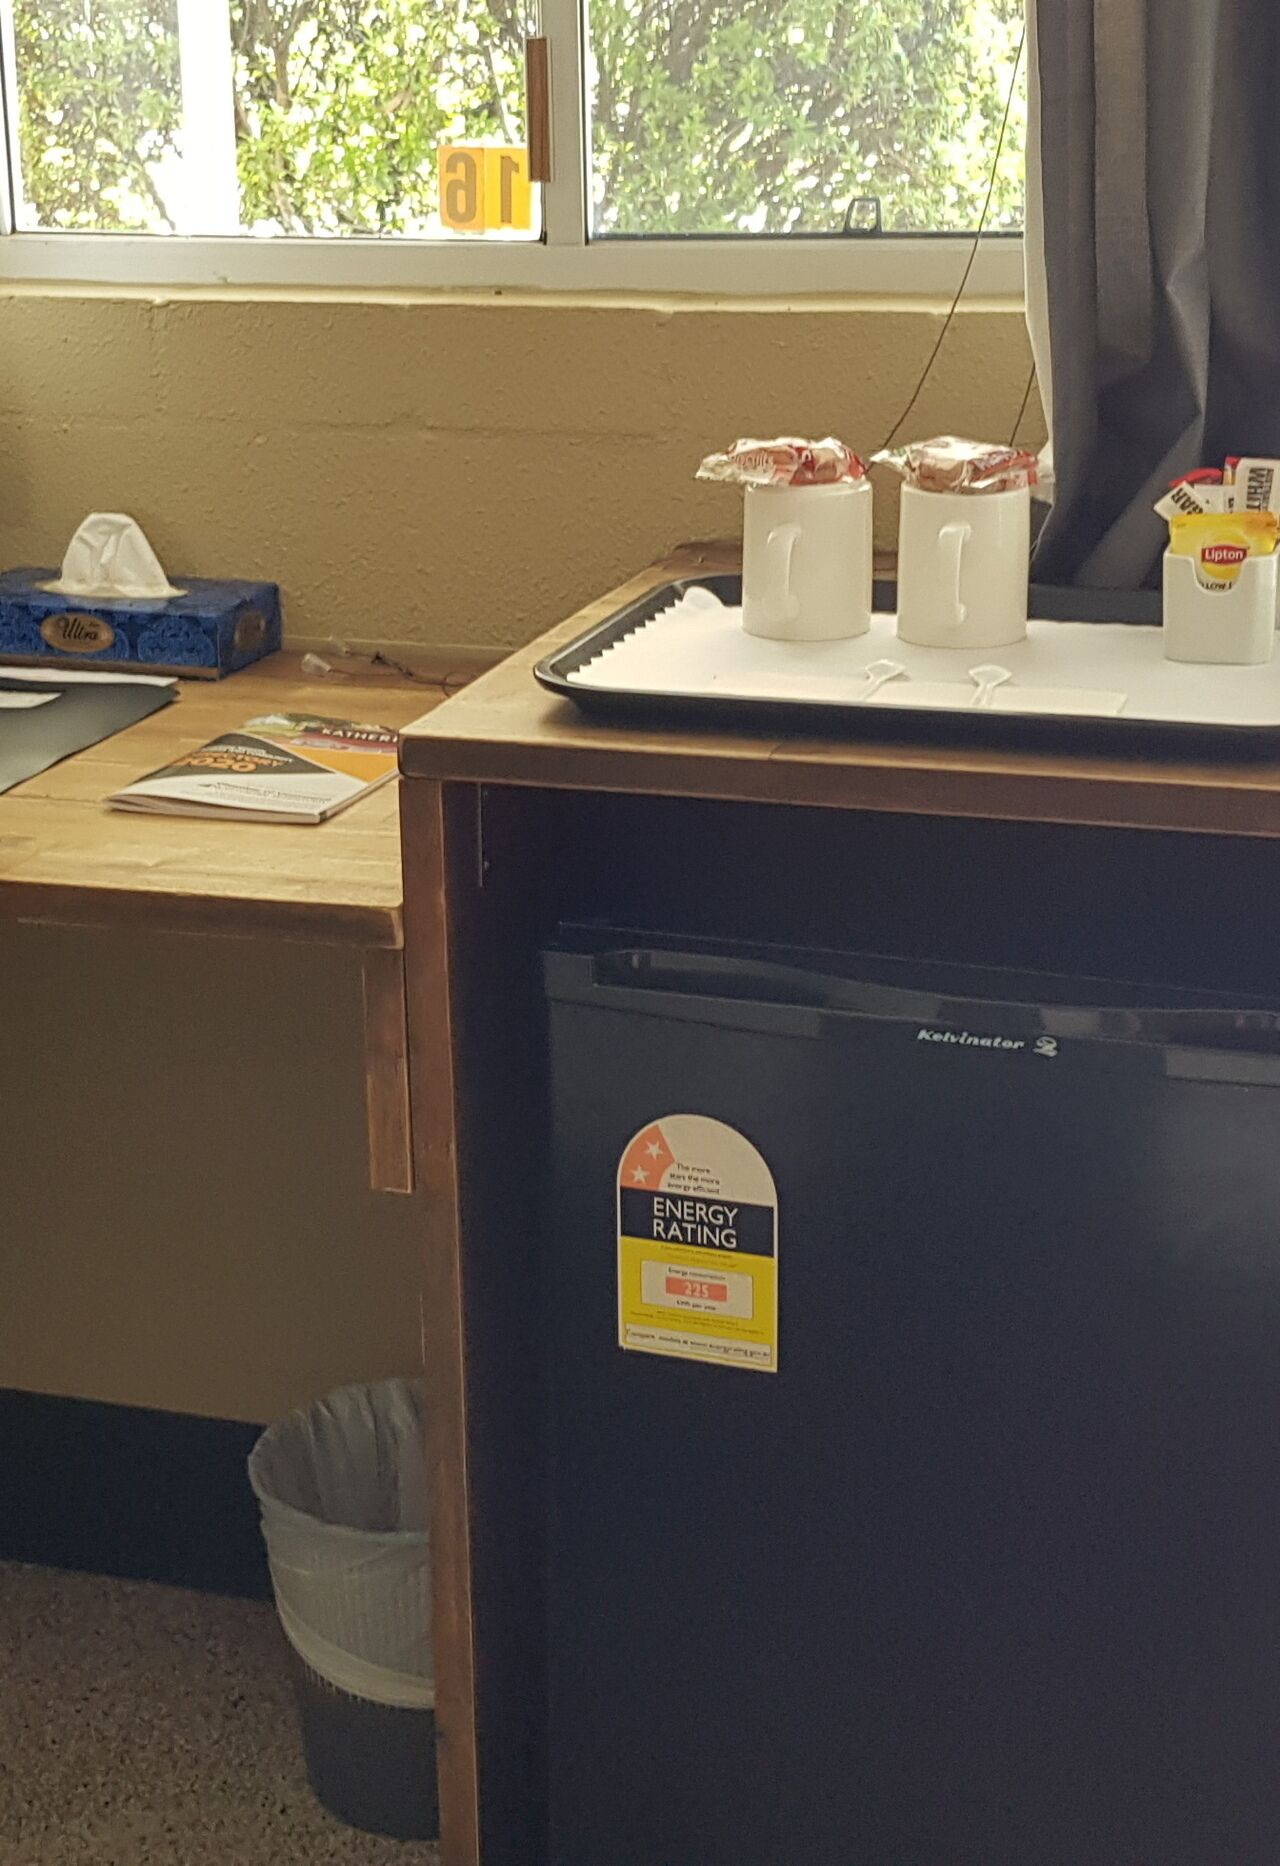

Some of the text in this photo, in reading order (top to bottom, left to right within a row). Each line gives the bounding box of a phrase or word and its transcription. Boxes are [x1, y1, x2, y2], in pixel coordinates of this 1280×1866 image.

[1204, 548, 1244, 562] Lipton
[57, 616, 99, 640] Ultra
[917, 1029, 1025, 1050] Kelvinator
[653, 1196, 738, 1227] ENERGY
[653, 1218, 737, 1249] RATING
